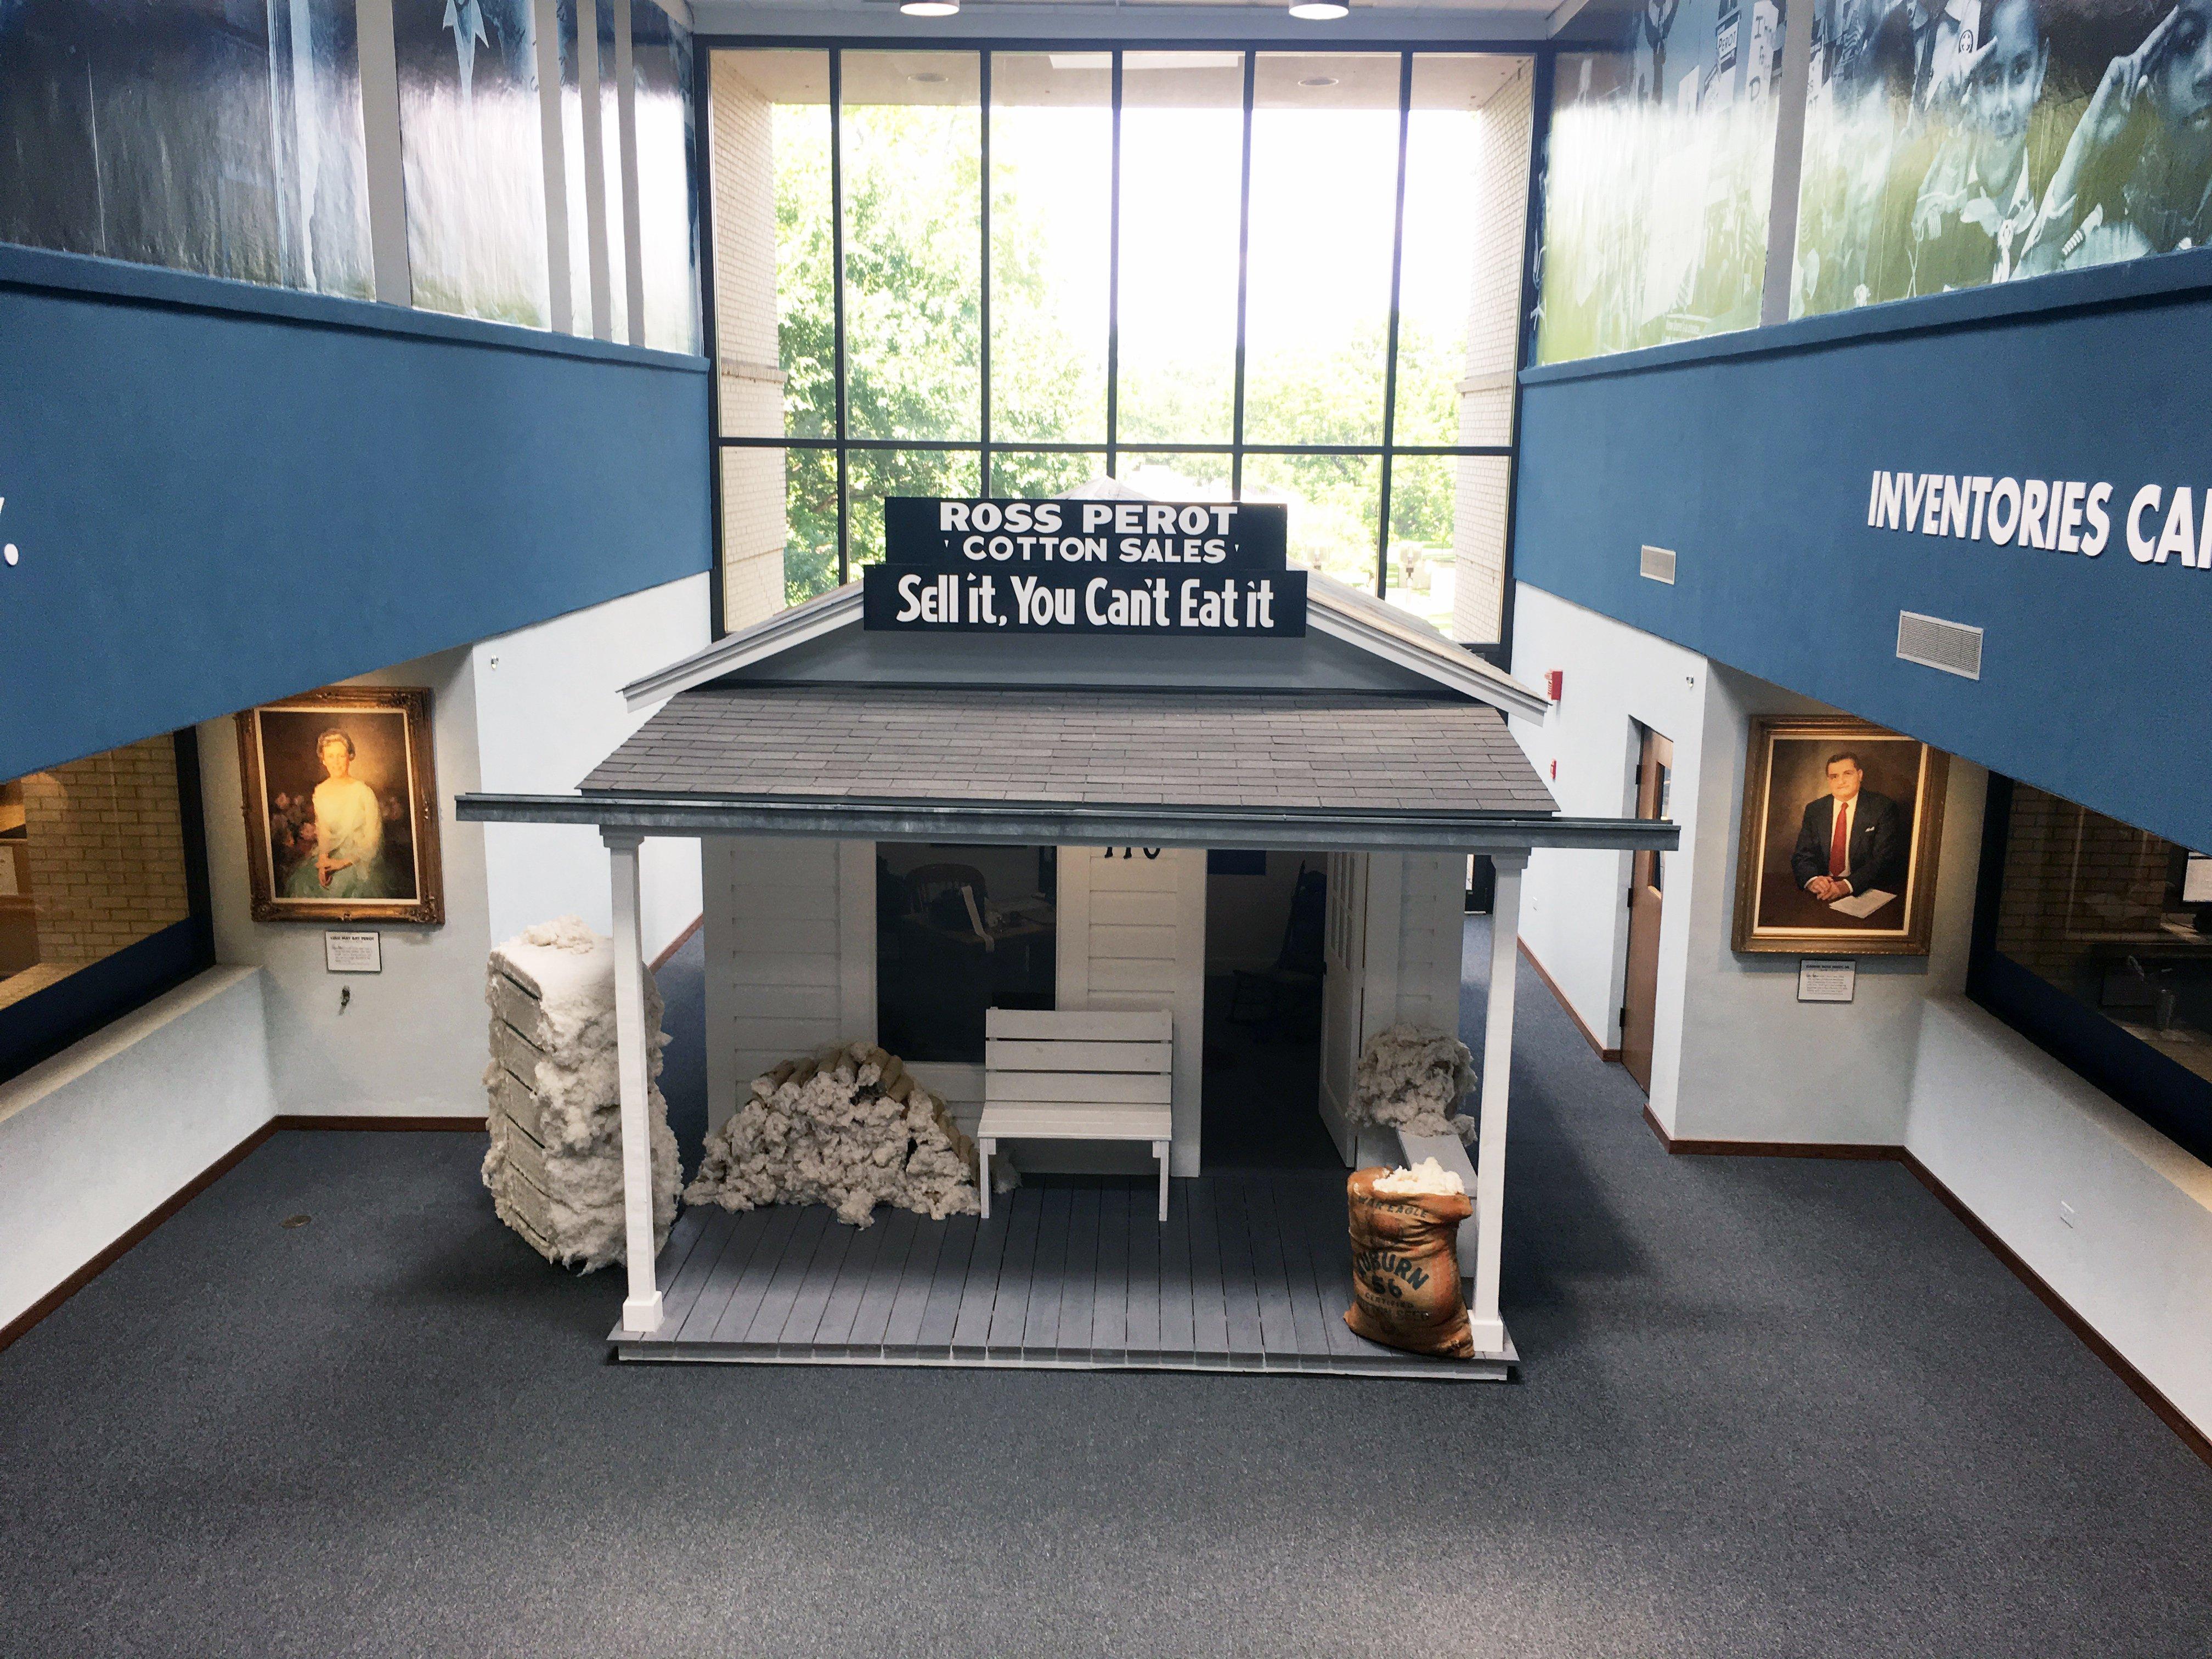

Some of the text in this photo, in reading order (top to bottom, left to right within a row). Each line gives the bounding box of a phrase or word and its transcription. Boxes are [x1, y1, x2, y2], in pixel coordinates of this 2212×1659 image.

[940, 501, 1238, 535] ROSS PEROT
[1867, 470, 2114, 557] INVENTORIES
[963, 535, 1227, 564] COTTON SALES
[896, 572, 1274, 629] Sell it, You Can't Eat it
[1387, 1204, 1428, 1218] EAGLE
[1357, 1250, 1430, 1291] AUBURN
[1372, 1274, 1403, 1299] 56
